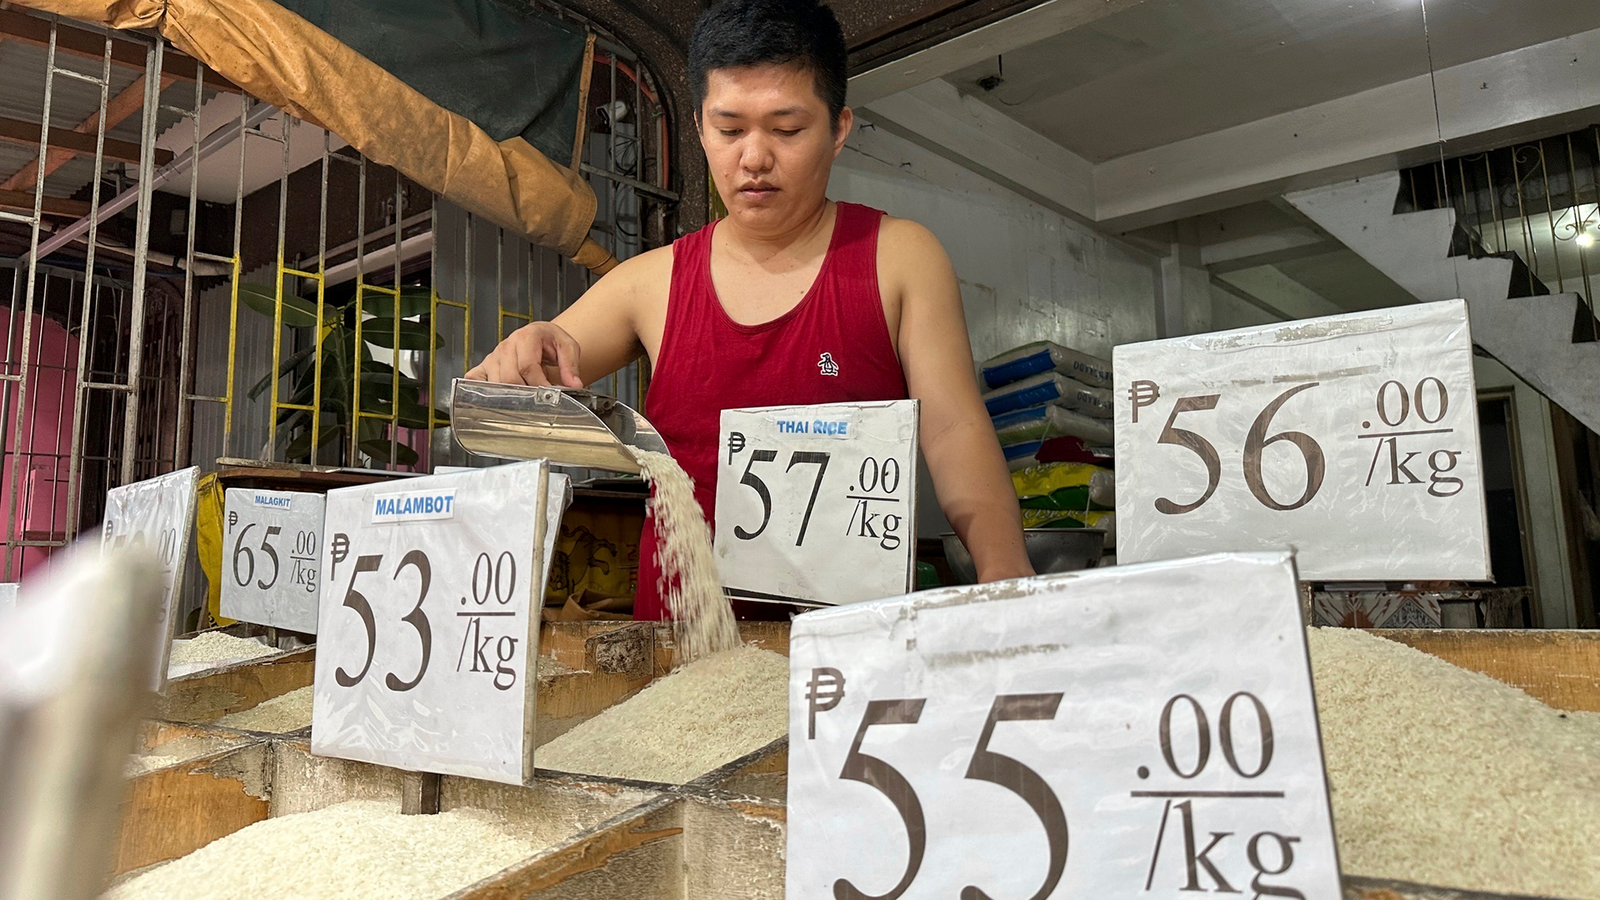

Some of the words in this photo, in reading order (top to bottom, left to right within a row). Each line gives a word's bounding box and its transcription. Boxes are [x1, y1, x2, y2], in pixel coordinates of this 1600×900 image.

[777, 421, 809, 434] THAI
[812, 419, 848, 436] RICE
[254, 495, 291, 507] MALAGKIT
[375, 495, 454, 515] MALAMBOT
